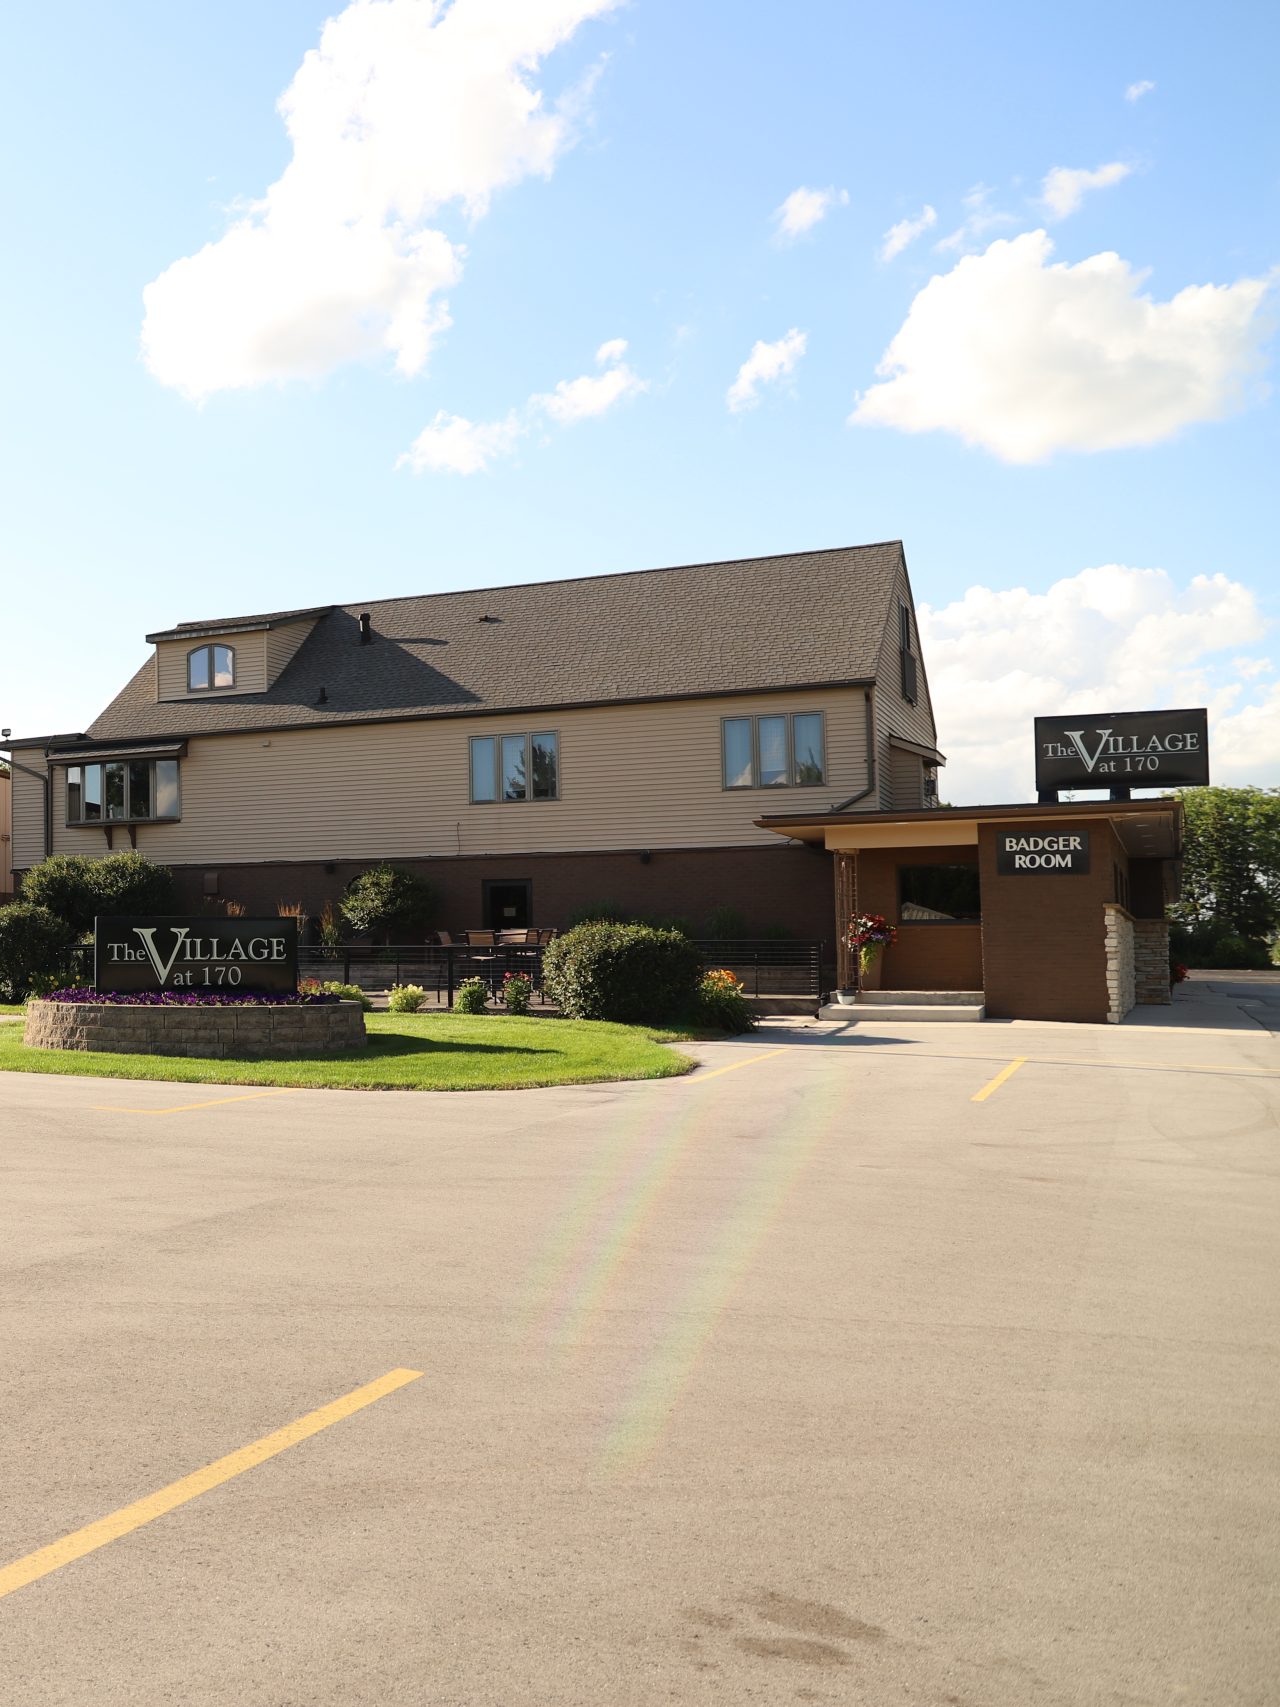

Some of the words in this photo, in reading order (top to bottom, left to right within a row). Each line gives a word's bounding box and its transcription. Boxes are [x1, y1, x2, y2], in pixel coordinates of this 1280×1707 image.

[1043, 743, 1076, 757] The
[1064, 729, 1200, 773] VILLAGE
[1099, 760, 1116, 773] at
[1124, 756, 1159, 772] 170
[1005, 836, 1082, 852] BADGER
[1014, 854, 1072, 869] ROOM
[107, 943, 146, 961] The
[132, 927, 287, 986] VILLAGE
[173, 969, 193, 986] at
[202, 966, 242, 986] 170
